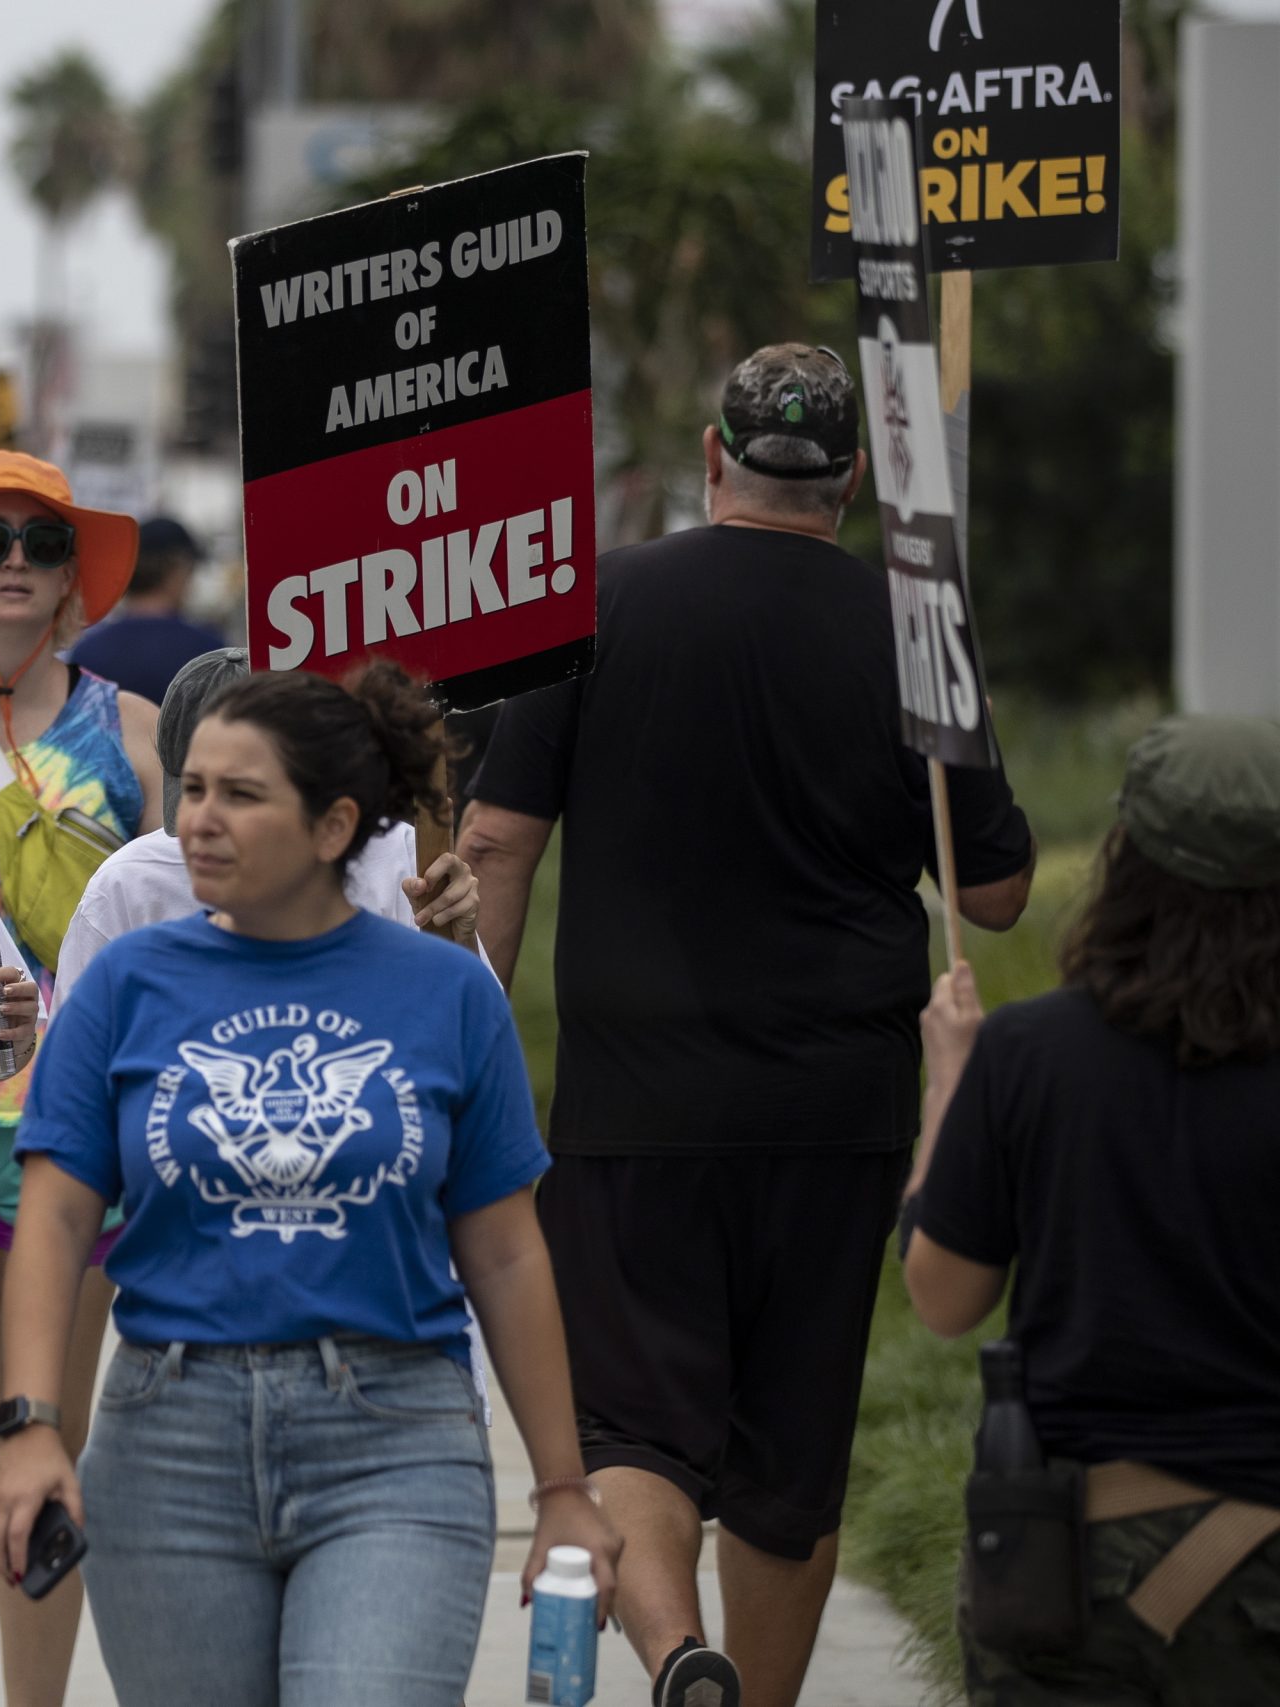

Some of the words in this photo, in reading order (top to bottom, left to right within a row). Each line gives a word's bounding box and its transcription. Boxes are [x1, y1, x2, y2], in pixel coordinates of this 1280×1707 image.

[931, 125, 988, 160] ON
[824, 155, 1106, 233] SRIKE!
[259, 241, 443, 329] WRITERS
[450, 209, 563, 279] GUILD
[394, 305, 437, 351] OF
[325, 344, 509, 434] AMERICA
[386, 458, 458, 526] ON
[266, 496, 577, 673] STRIKE!
[211, 1003, 310, 1044] GUILD
[316, 1009, 363, 1041] OF
[380, 1066, 425, 1187] AMERICA
[260, 1207, 318, 1224] WEST
